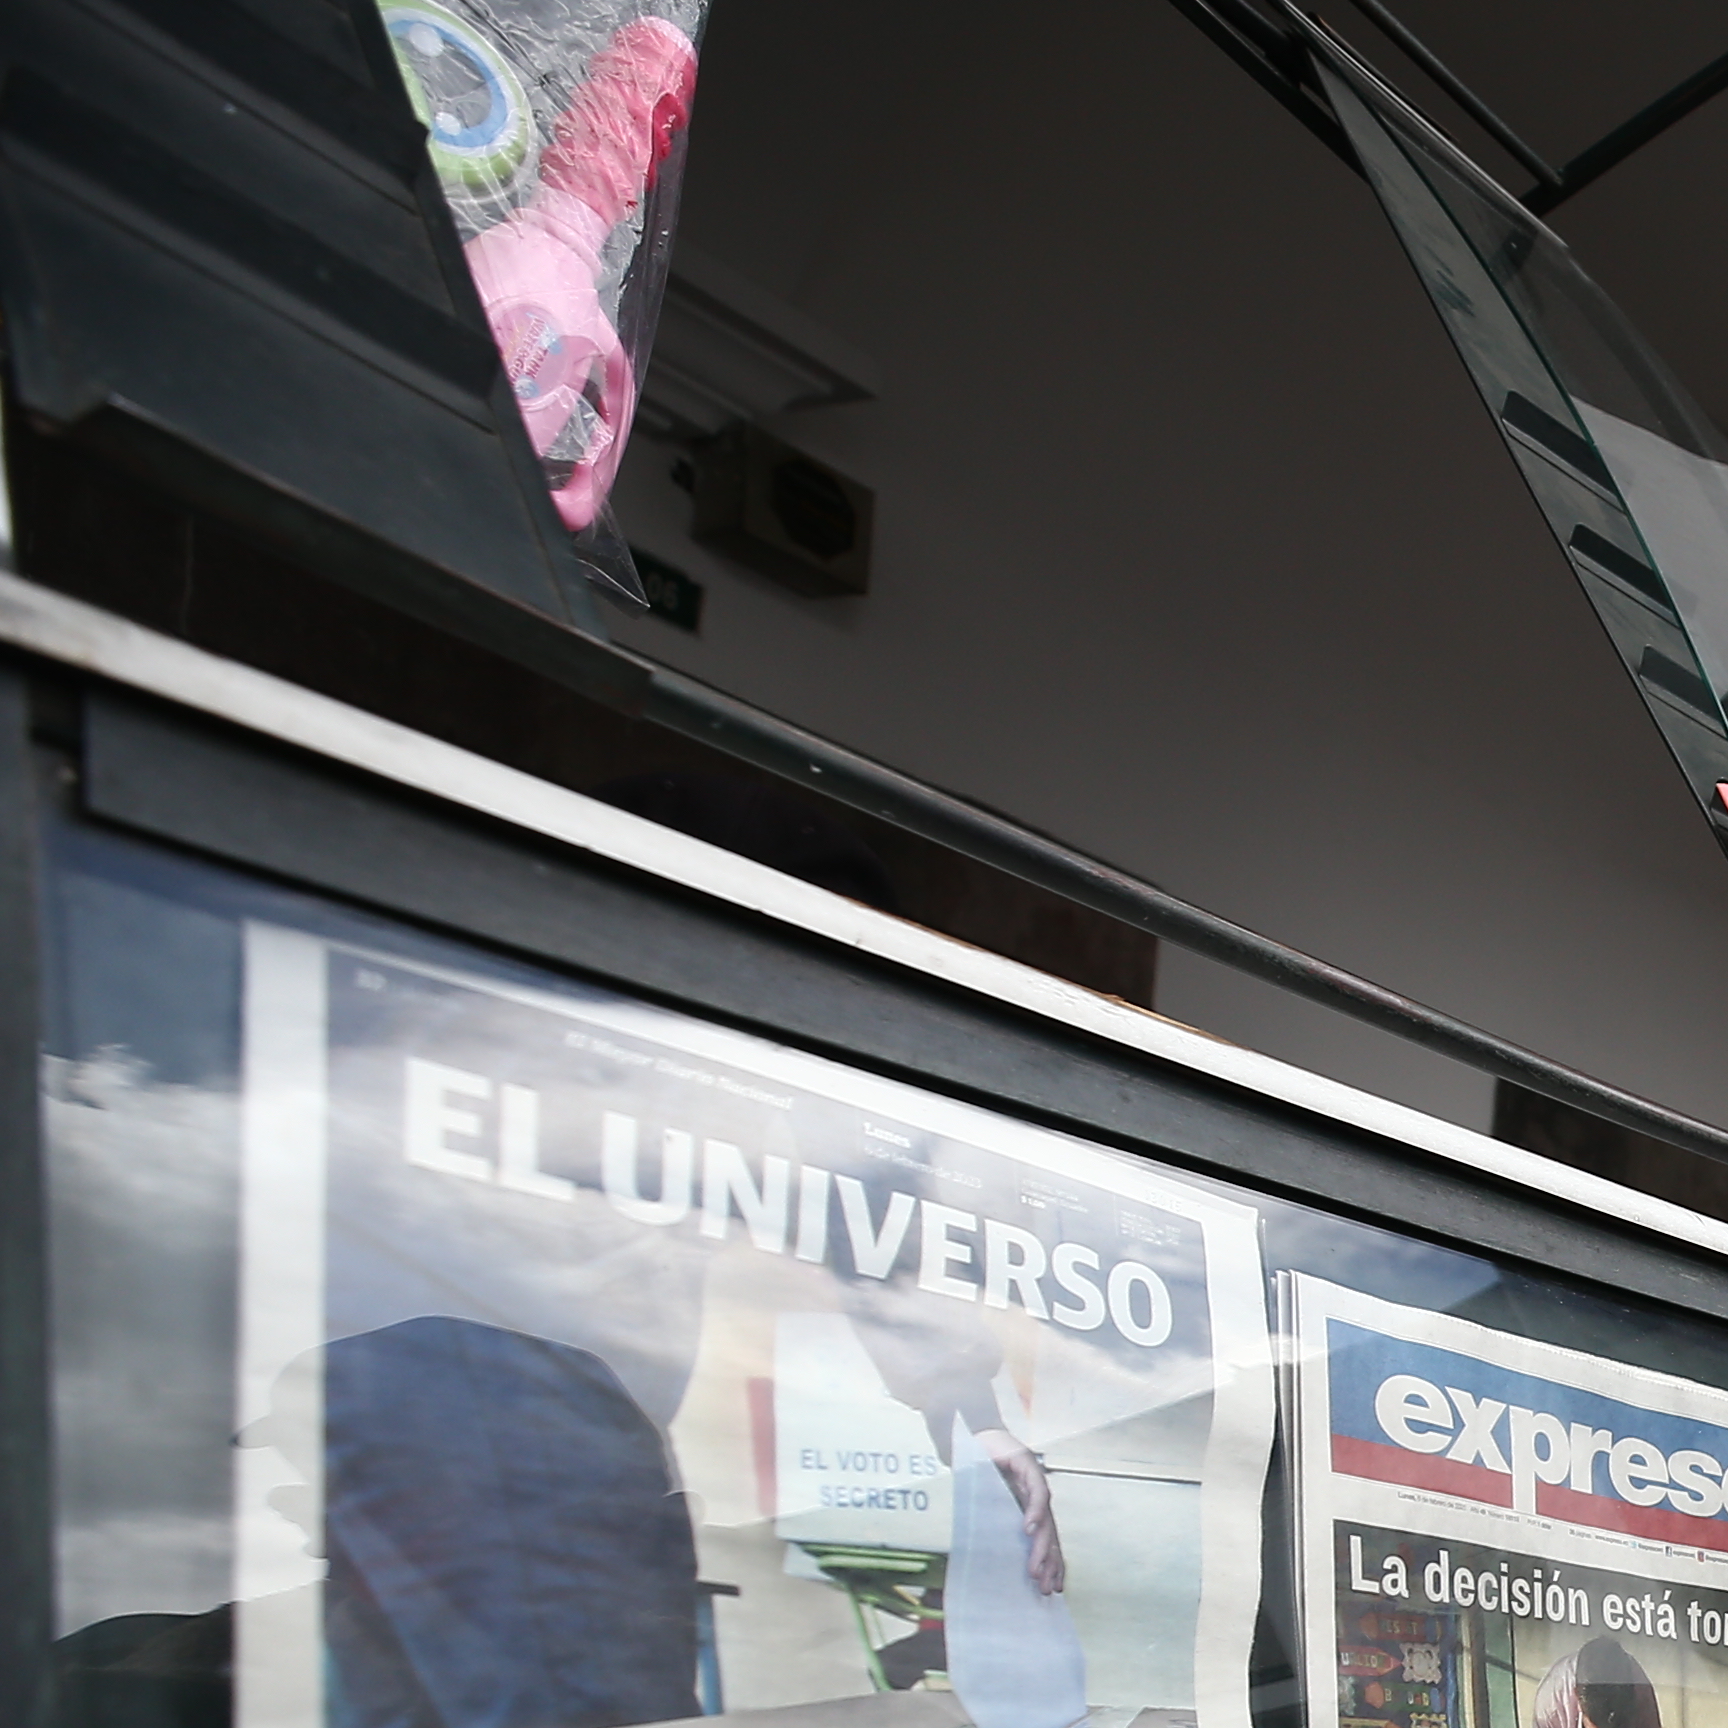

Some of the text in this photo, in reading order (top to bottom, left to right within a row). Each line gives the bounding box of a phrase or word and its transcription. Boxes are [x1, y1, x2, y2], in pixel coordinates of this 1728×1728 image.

[405, 1055, 1174, 1349] EL UNIVERSO
[801, 1449, 938, 1477] EL VOTO ES
[820, 1484, 929, 1512] SECRETO
[1349, 1535, 1411, 1600] La
[1423, 1549, 1591, 1628] decisión
[1602, 1589, 1678, 1641] está
